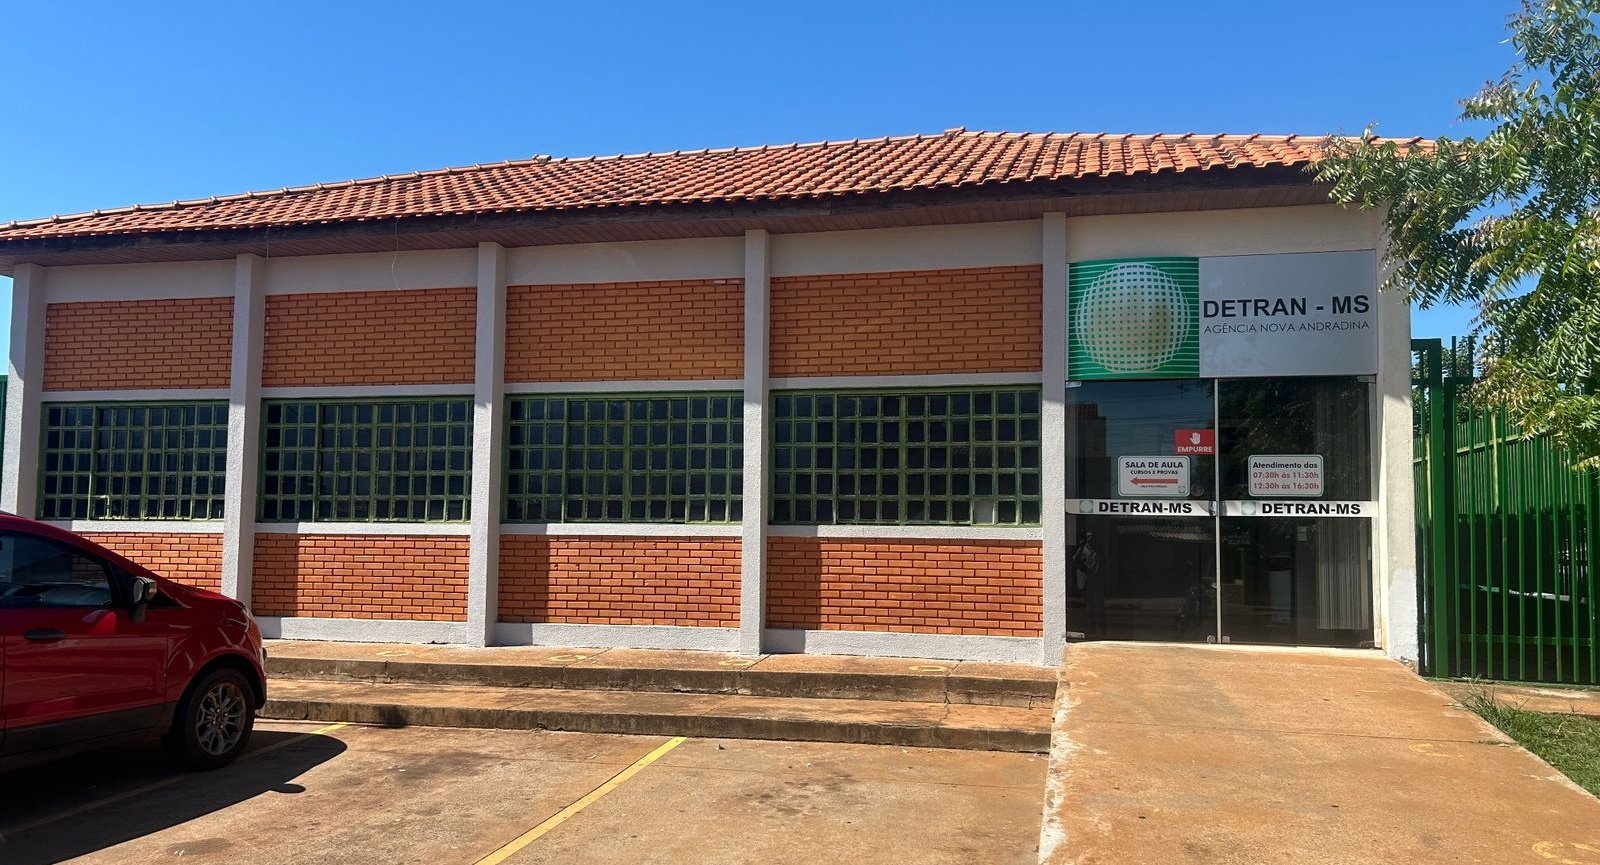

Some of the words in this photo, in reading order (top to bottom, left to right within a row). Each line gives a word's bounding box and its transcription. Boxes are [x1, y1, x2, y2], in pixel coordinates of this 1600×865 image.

[1203, 297, 1306, 318] DETRAN
[1332, 295, 1369, 314] MS
[1204, 323, 1256, 334] AGÊNCIA
[1260, 323, 1295, 333] NOVA
[1299, 320, 1370, 332] ANDRADINA
[1098, 502, 1192, 513] DETRAN-MS
[1262, 504, 1361, 515] DETRAN-MS
